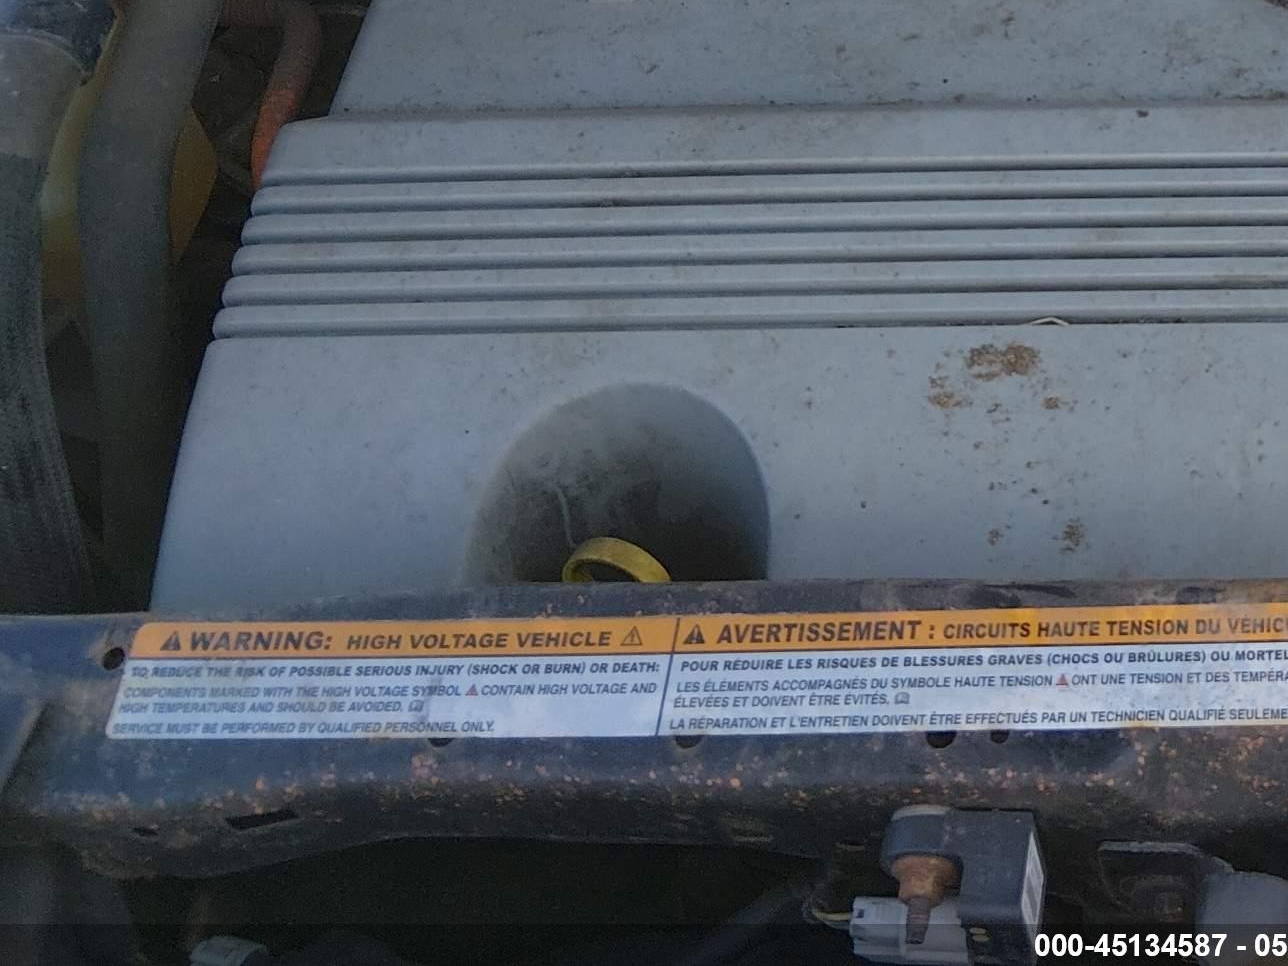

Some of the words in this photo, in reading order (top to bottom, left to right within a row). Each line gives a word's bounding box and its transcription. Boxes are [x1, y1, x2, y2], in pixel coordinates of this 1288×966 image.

[716, 620, 922, 644] AVERTISSEMENT
[943, 622, 1031, 639] CIRCUITS
[1037, 621, 1100, 637] HAUTE
[1106, 618, 1189, 637] TENSION
[1195, 618, 1220, 634] DU
[190, 631, 333, 651] WARNING:
[347, 634, 403, 650] HIGH
[410, 632, 508, 649] VOLTAGE
[517, 631, 612, 648] VEHICLE
[150, 666, 203, 677] REDUCE
[207, 666, 231, 677] THE
[234, 665, 264, 677] RISK
[268, 665, 286, 677] OF
[289, 665, 352, 677] POSSIBLE
[355, 664, 412, 677] SERIOUS
[415, 664, 464, 676] INJURY
[467, 663, 518, 675] (SHOCK
[522, 663, 541, 675] OR
[543, 662, 586, 675] BURN)
[589, 662, 608, 674] OR
[611, 662, 660, 673] DEATH:
[681, 660, 718, 672] POUR
[723, 657, 783, 671] RÉDUIRE
[787, 658, 813, 670] LES
[816, 657, 876, 669] RISQUES
[881, 656, 899, 668] DE
[903, 655, 983, 668] BLESSURES
[988, 654, 1042, 666] GRAVES
[1047, 653, 1099, 666] (CHOCS
[1104, 653, 1123, 663] OU
[1128, 649, 1207, 664] BRÛLURES)
[1210, 650, 1230, 661] OU
[123, 686, 206, 698] COMPONENTS
[209, 686, 260, 698] MARKED
[262, 686, 293, 698] WITH
[296, 686, 319, 698] THE
[321, 686, 351, 697] HIGH
[354, 685, 409, 698] VOLTAGE
[411, 684, 462, 696] SYMBOL
[481, 683, 535, 696] CONTAIN
[537, 683, 568, 695] HIGH
[571, 683, 627, 695] VOLTAGE
[630, 682, 657, 694] AND
[677, 681, 701, 693] LES
[704, 678, 769, 692] ÉLÉMENTS
[773, 677, 866, 691] ACCOMPAGNÉS
[871, 678, 888, 689] DU
[891, 677, 951, 689] SYMBOLE
[954, 676, 995, 688] HAUTE
[999, 675, 1052, 687] TENSION
[1072, 674, 1097, 685] ONT
[1101, 673, 1126, 685] UNE
[1130, 672, 1184, 684] TENSION
[1187, 672, 1202, 683] ET
[1206, 671, 1230, 683] DES
[118, 701, 148, 713] HIGH
[152, 701, 245, 713] TEMPERATURES
[248, 701, 273, 713] AND
[276, 701, 326, 713] SHOULD
[329, 701, 345, 712] BE
[347, 700, 403, 713] AVOIDED.
[673, 694, 729, 709] ÉLEVÉES
[733, 696, 748, 707] ET
[752, 695, 806, 707] DOIVENT
[809, 693, 841, 706] ÊTRE
[844, 692, 889, 705] ÉVITÉS.
[112, 722, 164, 734] SERVICE
[167, 722, 200, 734] MUST
[202, 722, 218, 734] BE
[220, 722, 295, 734] PERFORMED
[298, 721, 315, 733] BY
[318, 721, 382, 733] QUALIFIED
[384, 721, 457, 732] PERSONNEL
[461, 720, 494, 732] ONLY.
[669, 717, 685, 730] LA
[688, 716, 768, 729] RÉPARATION
[770, 717, 786, 728] ET
[789, 715, 868, 728] L'ENTRETIEN
[872, 714, 926, 726] DOIVENT
[928, 711, 961, 725] ÊTRE
[965, 710, 1038, 724] EFFECTUÉS
[1041, 711, 1066, 723] PAR
[1070, 711, 1087, 723] UN
[1091, 709, 1165, 722] TECHNICIEN
[1169, 707, 1225, 720] QUALIFIÉ
